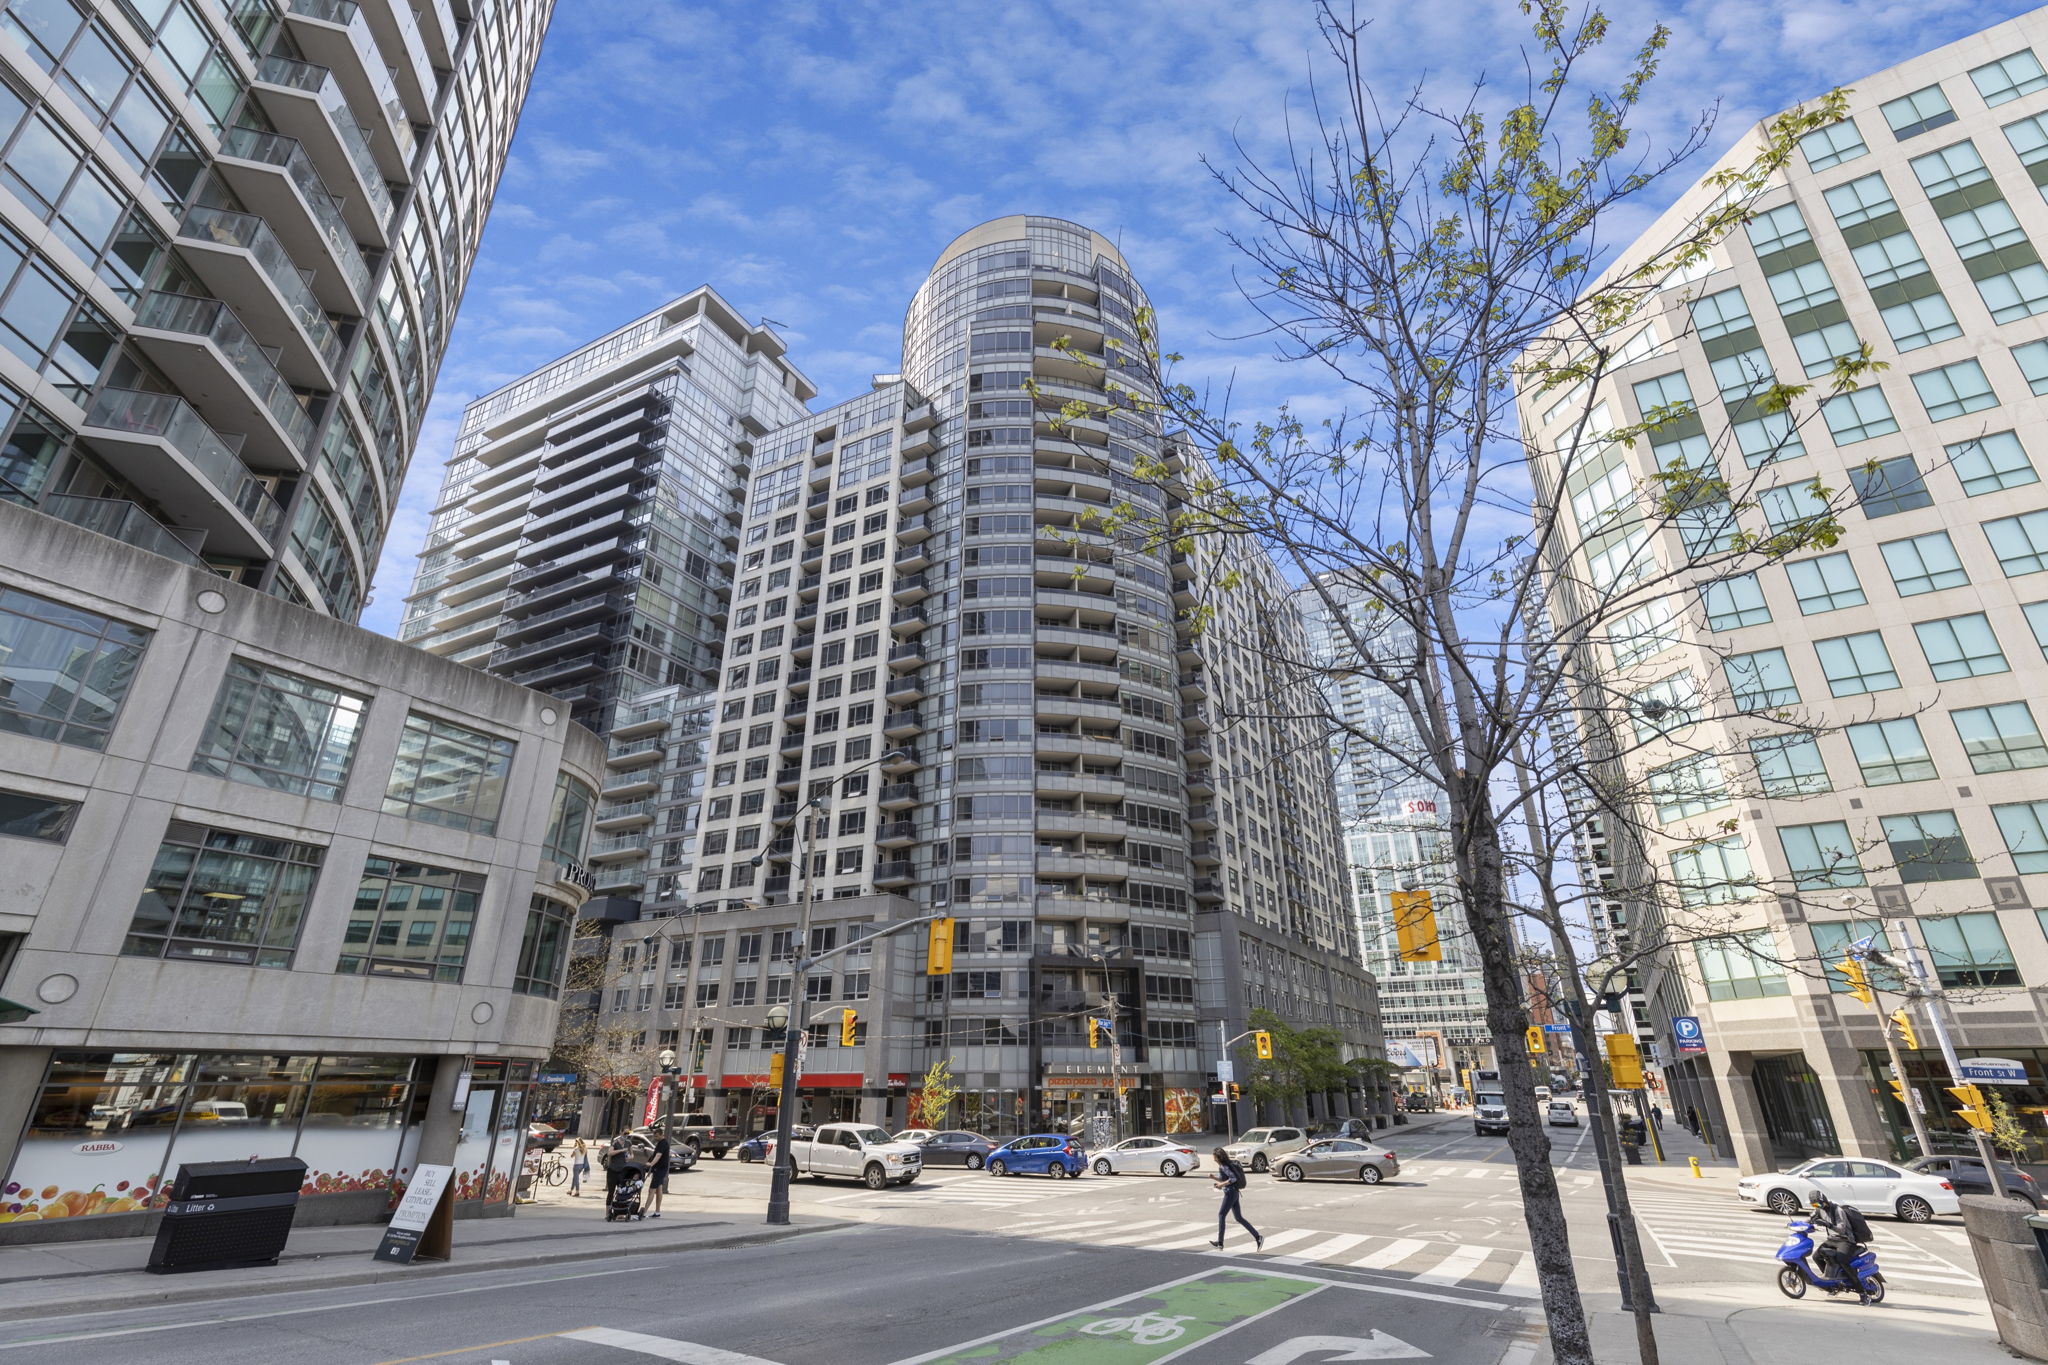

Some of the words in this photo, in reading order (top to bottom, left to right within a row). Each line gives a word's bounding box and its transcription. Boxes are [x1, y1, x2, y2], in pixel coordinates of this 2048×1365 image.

[1968, 1068, 1994, 1077] Front
[2007, 1069, 2017, 1077] W
[1048, 1077, 1073, 1087] pizza
[1073, 1077, 1097, 1087] pizza
[81, 1143, 116, 1152] RABBA
[185, 1203, 206, 1213] Litter
